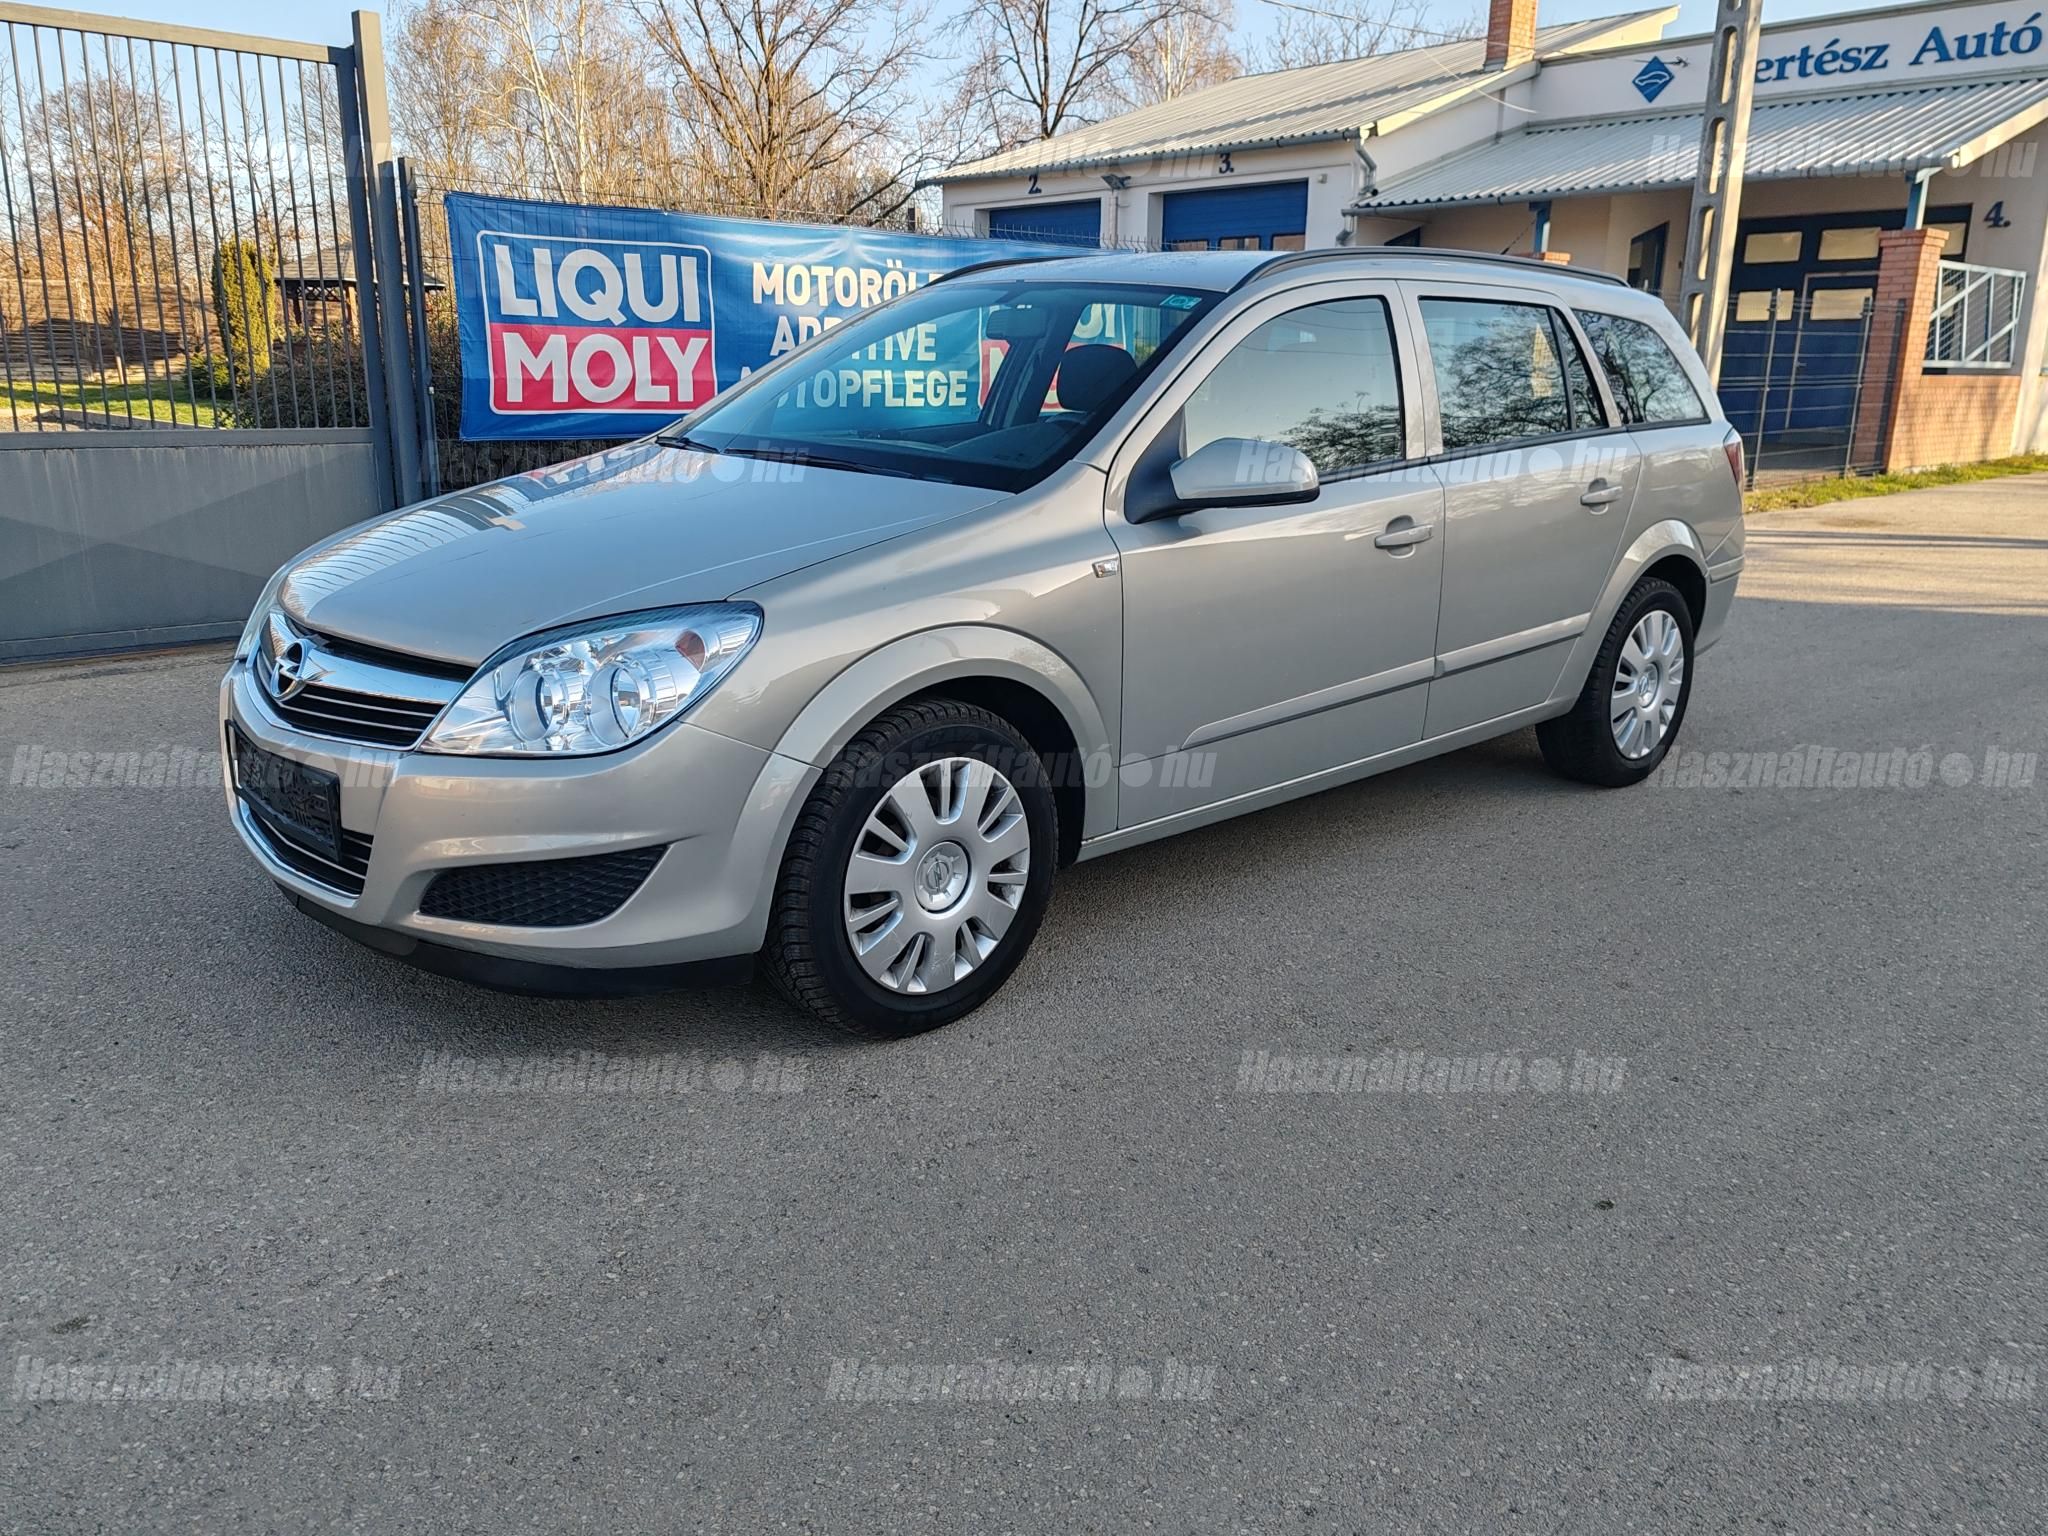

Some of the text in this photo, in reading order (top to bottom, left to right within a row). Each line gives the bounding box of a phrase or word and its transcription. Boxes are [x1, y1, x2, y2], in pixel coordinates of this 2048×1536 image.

[1754, 12, 2043, 84] ertész Autó
[1983, 200, 2011, 228] 4.
[494, 244, 701, 326] LIQUI
[752, 258, 945, 309] MOTORÖ
[502, 332, 709, 404] MOLY
